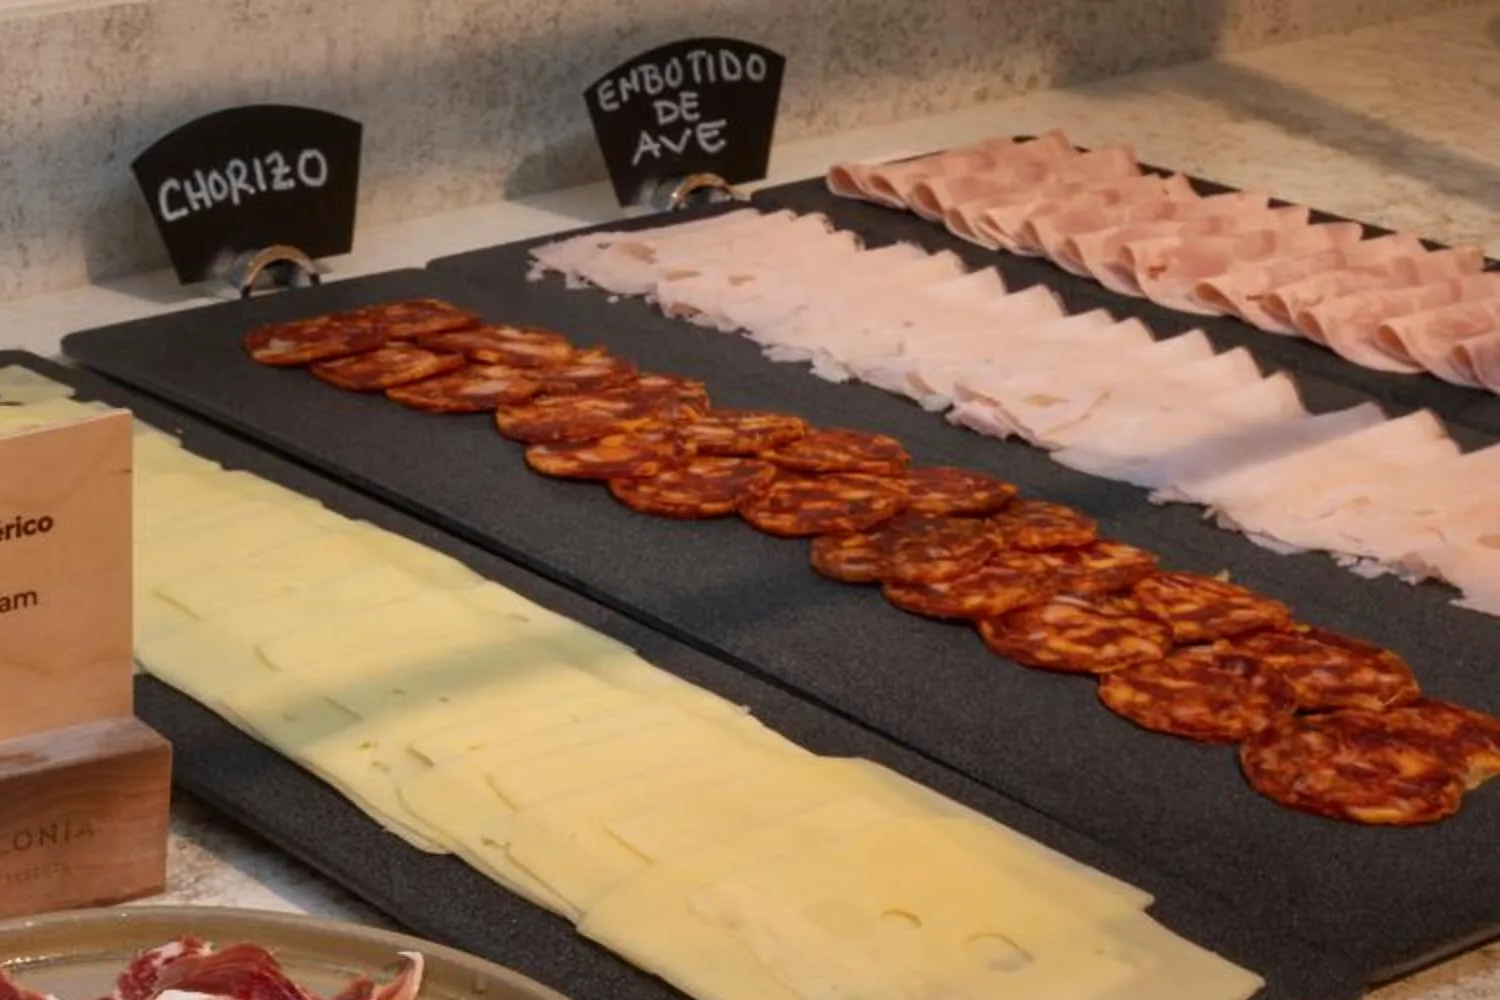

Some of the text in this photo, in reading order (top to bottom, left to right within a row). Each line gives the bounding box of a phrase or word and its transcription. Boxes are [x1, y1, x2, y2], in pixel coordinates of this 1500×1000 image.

[653, 91, 701, 126] DE
[632, 118, 727, 166] AVE
[158, 148, 328, 222] CHORIZO
